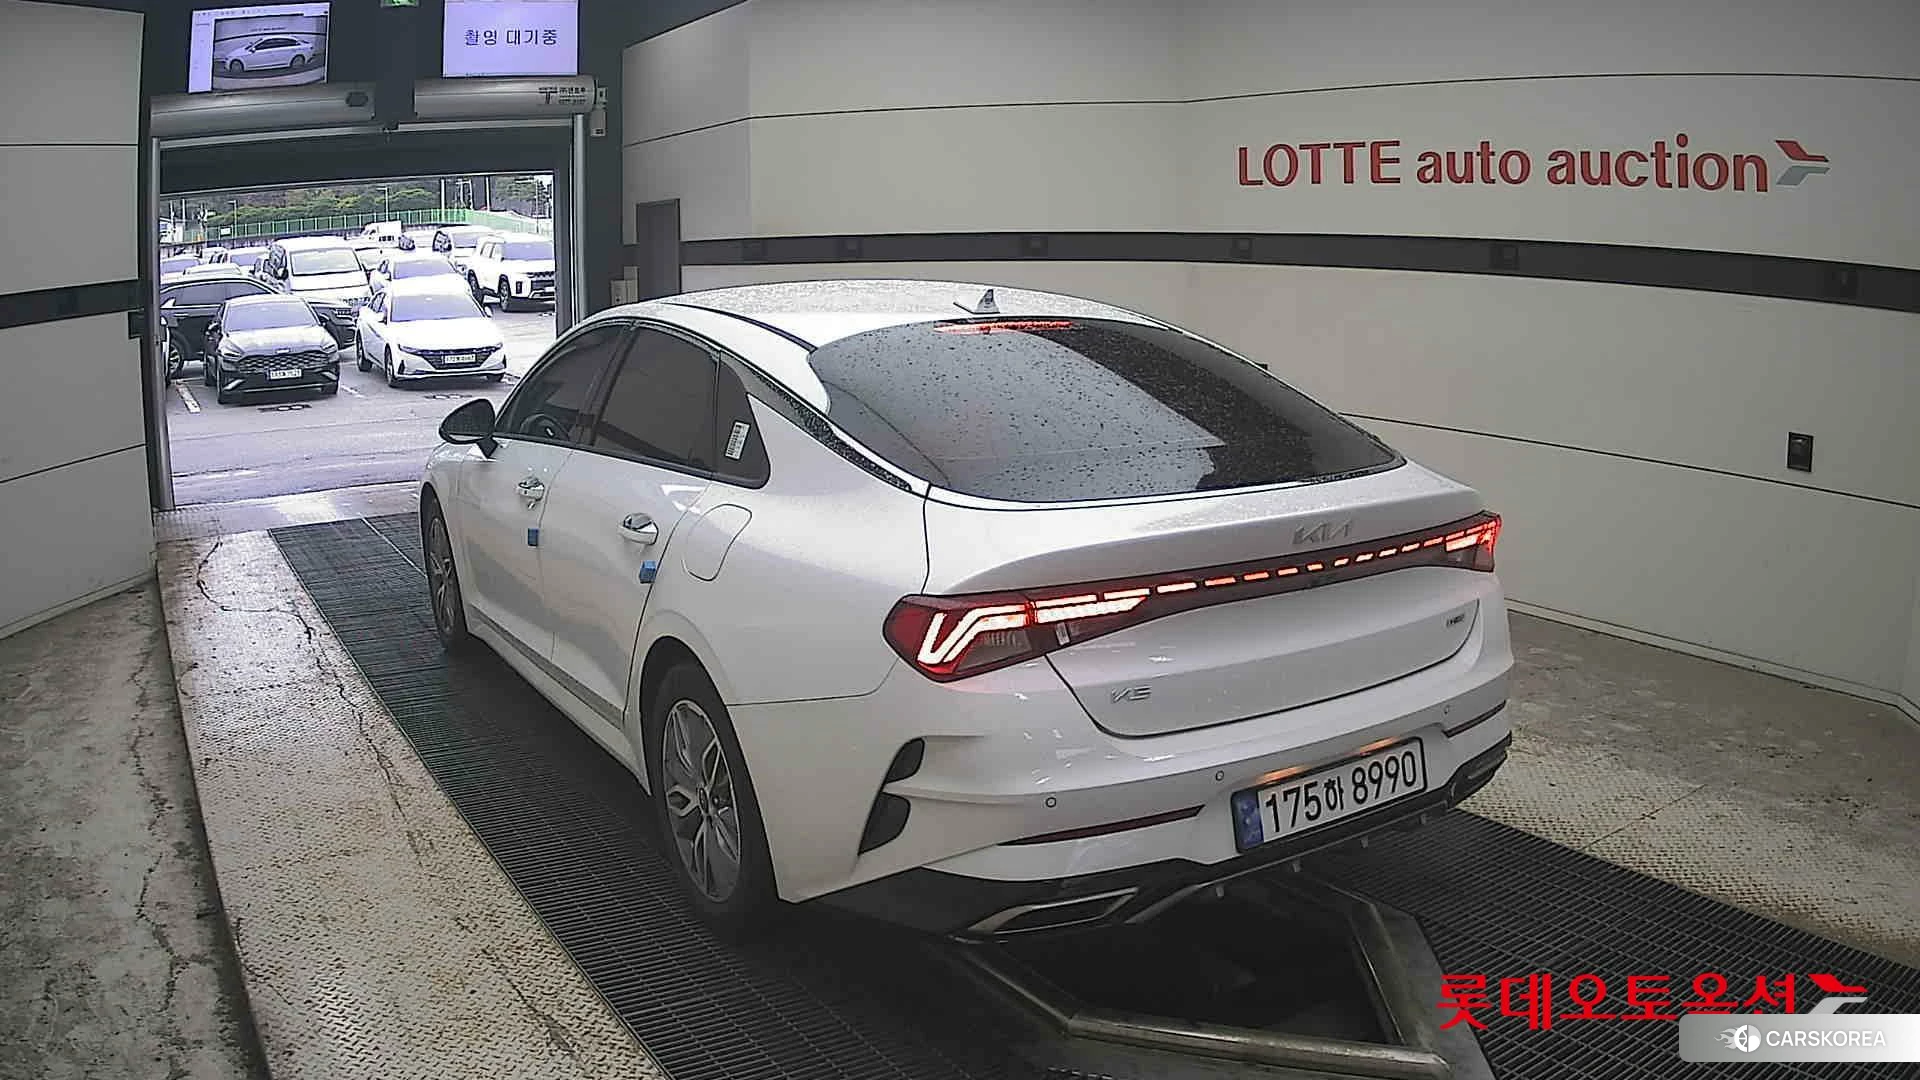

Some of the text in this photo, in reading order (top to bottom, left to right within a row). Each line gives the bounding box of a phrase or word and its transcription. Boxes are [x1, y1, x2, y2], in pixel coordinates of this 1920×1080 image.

[506, 28, 557, 46] 대기중
[1238, 133, 1768, 193] LOTTE auto auction
[1265, 751, 1417, 833] 175하 8990
